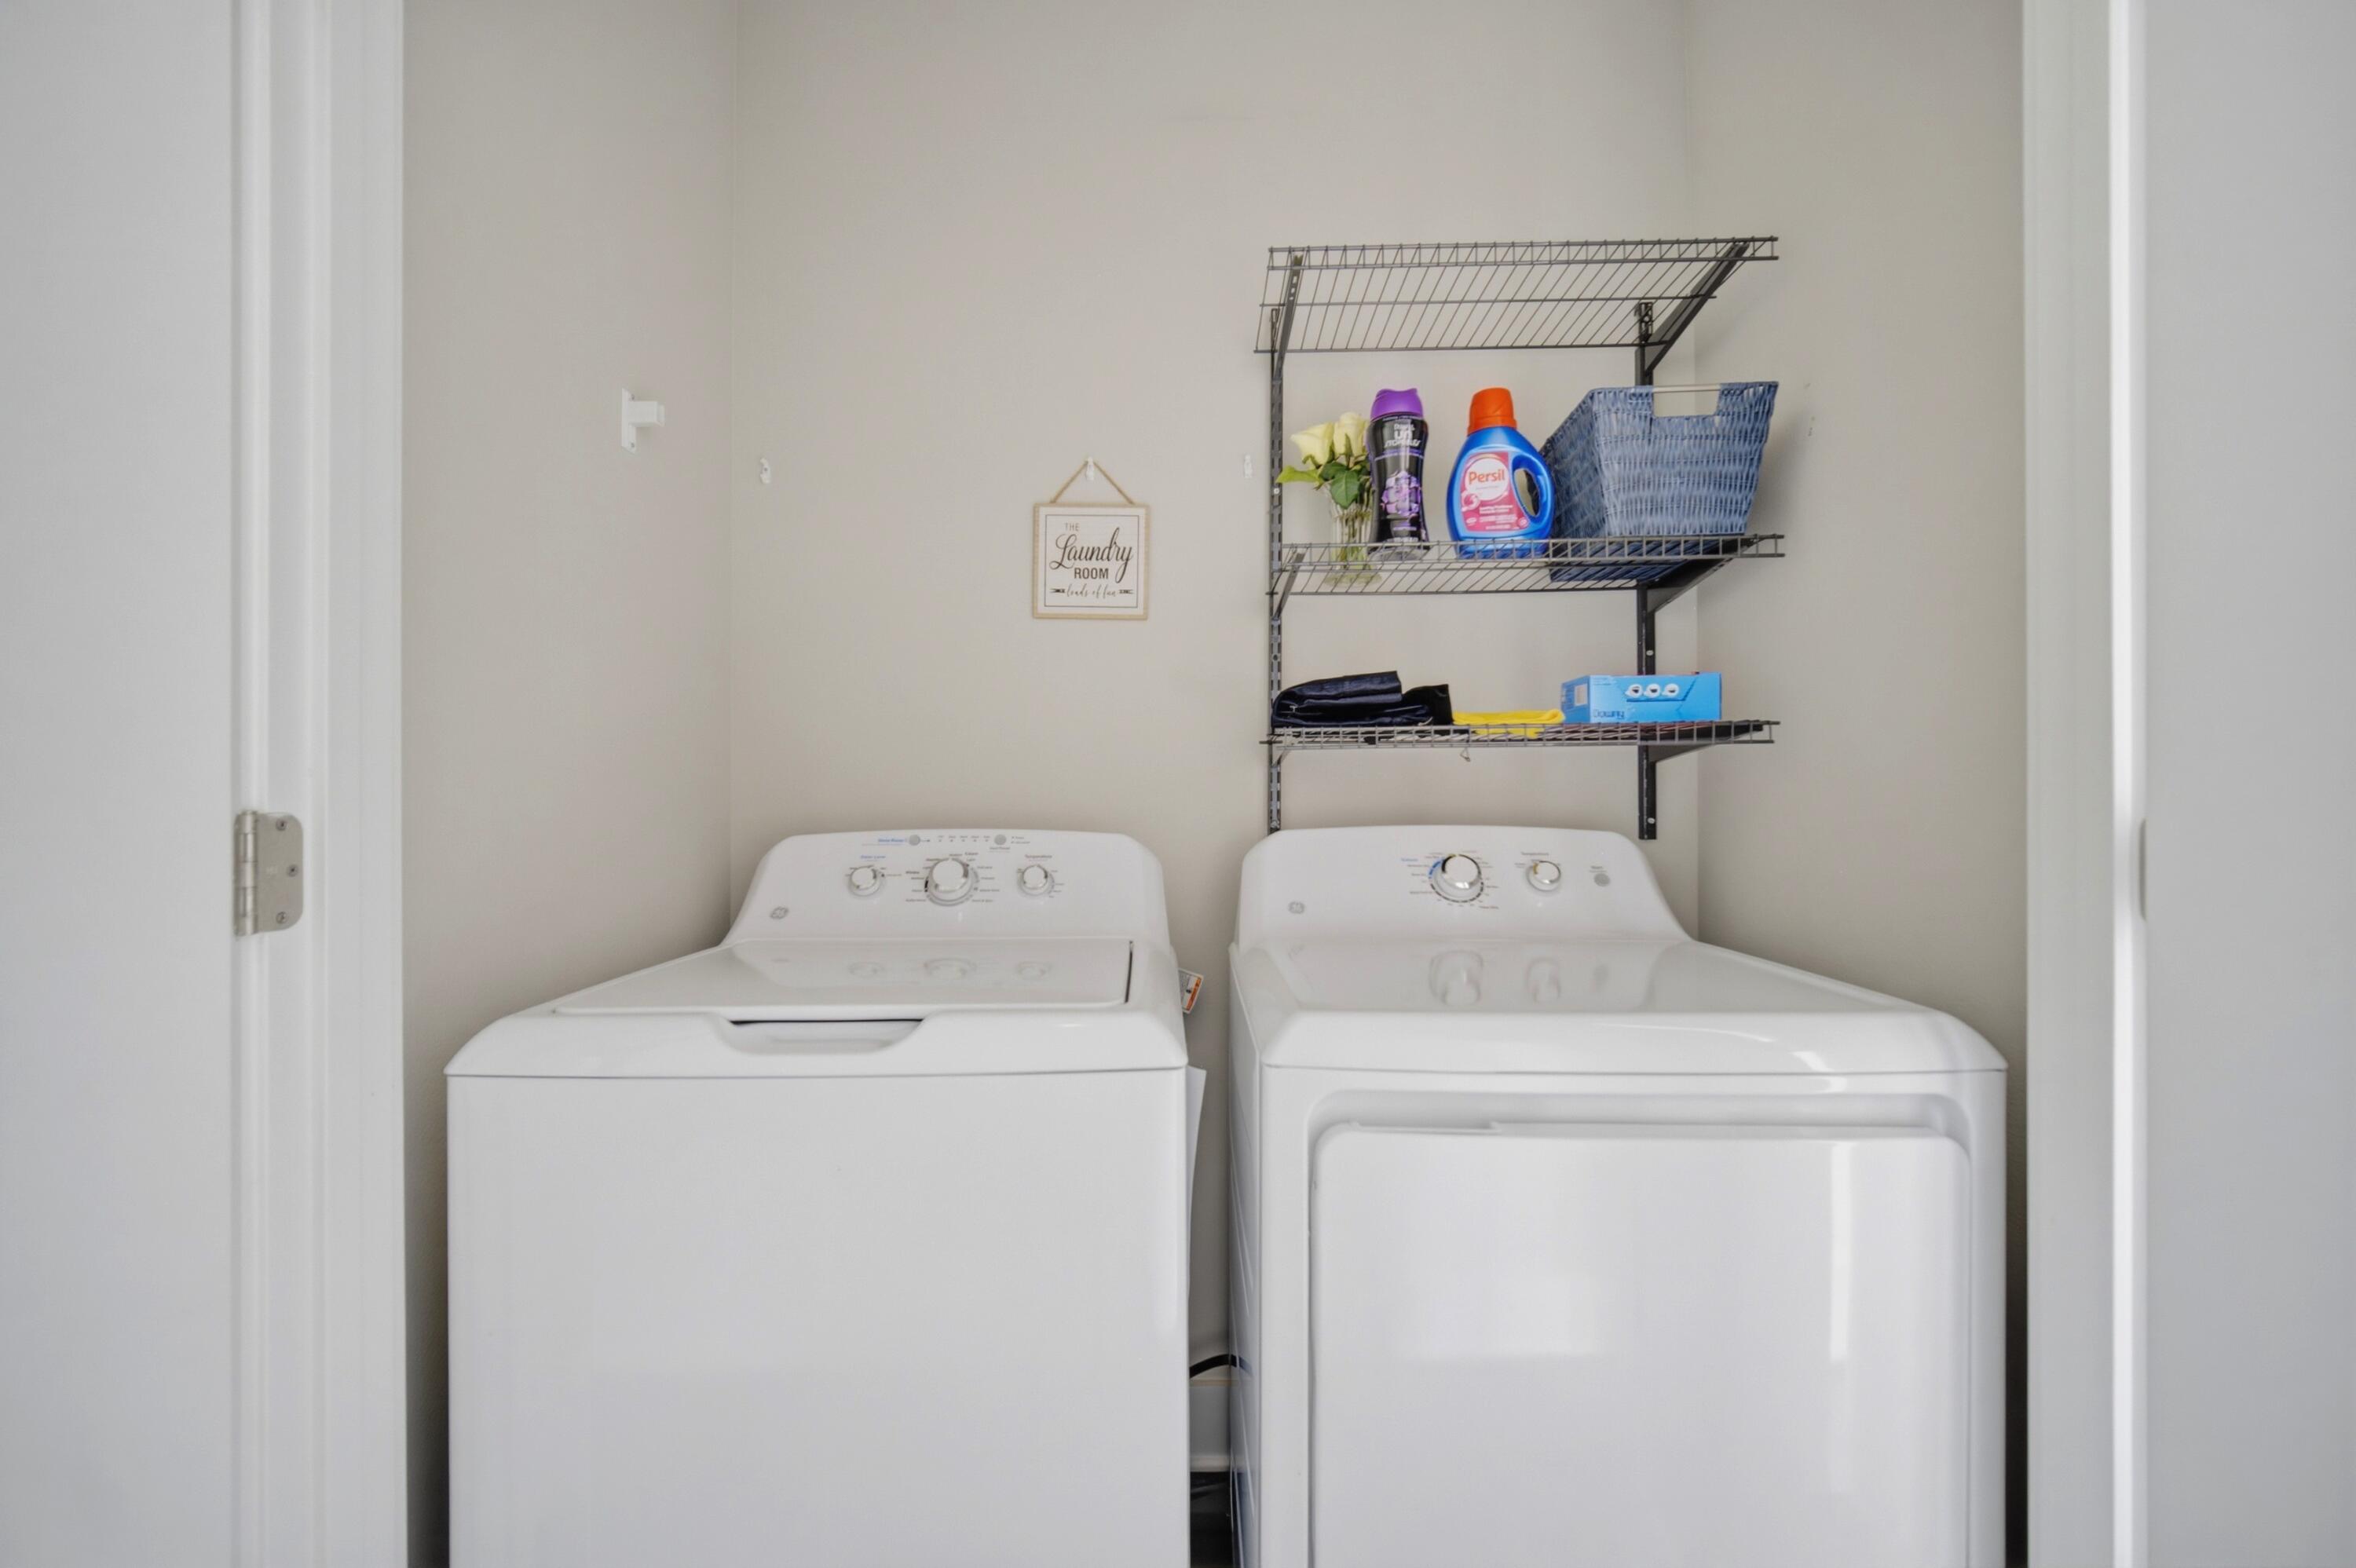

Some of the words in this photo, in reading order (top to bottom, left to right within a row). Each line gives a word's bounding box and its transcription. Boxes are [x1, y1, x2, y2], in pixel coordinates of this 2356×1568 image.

[1469, 469, 1505, 485] Persil
[1064, 522, 1080, 532] THE
[1049, 527, 1134, 583] Laundry
[1074, 567, 1109, 579] ROOM
[1066, 583, 1088, 598] loads
[1092, 583, 1102, 598] of
